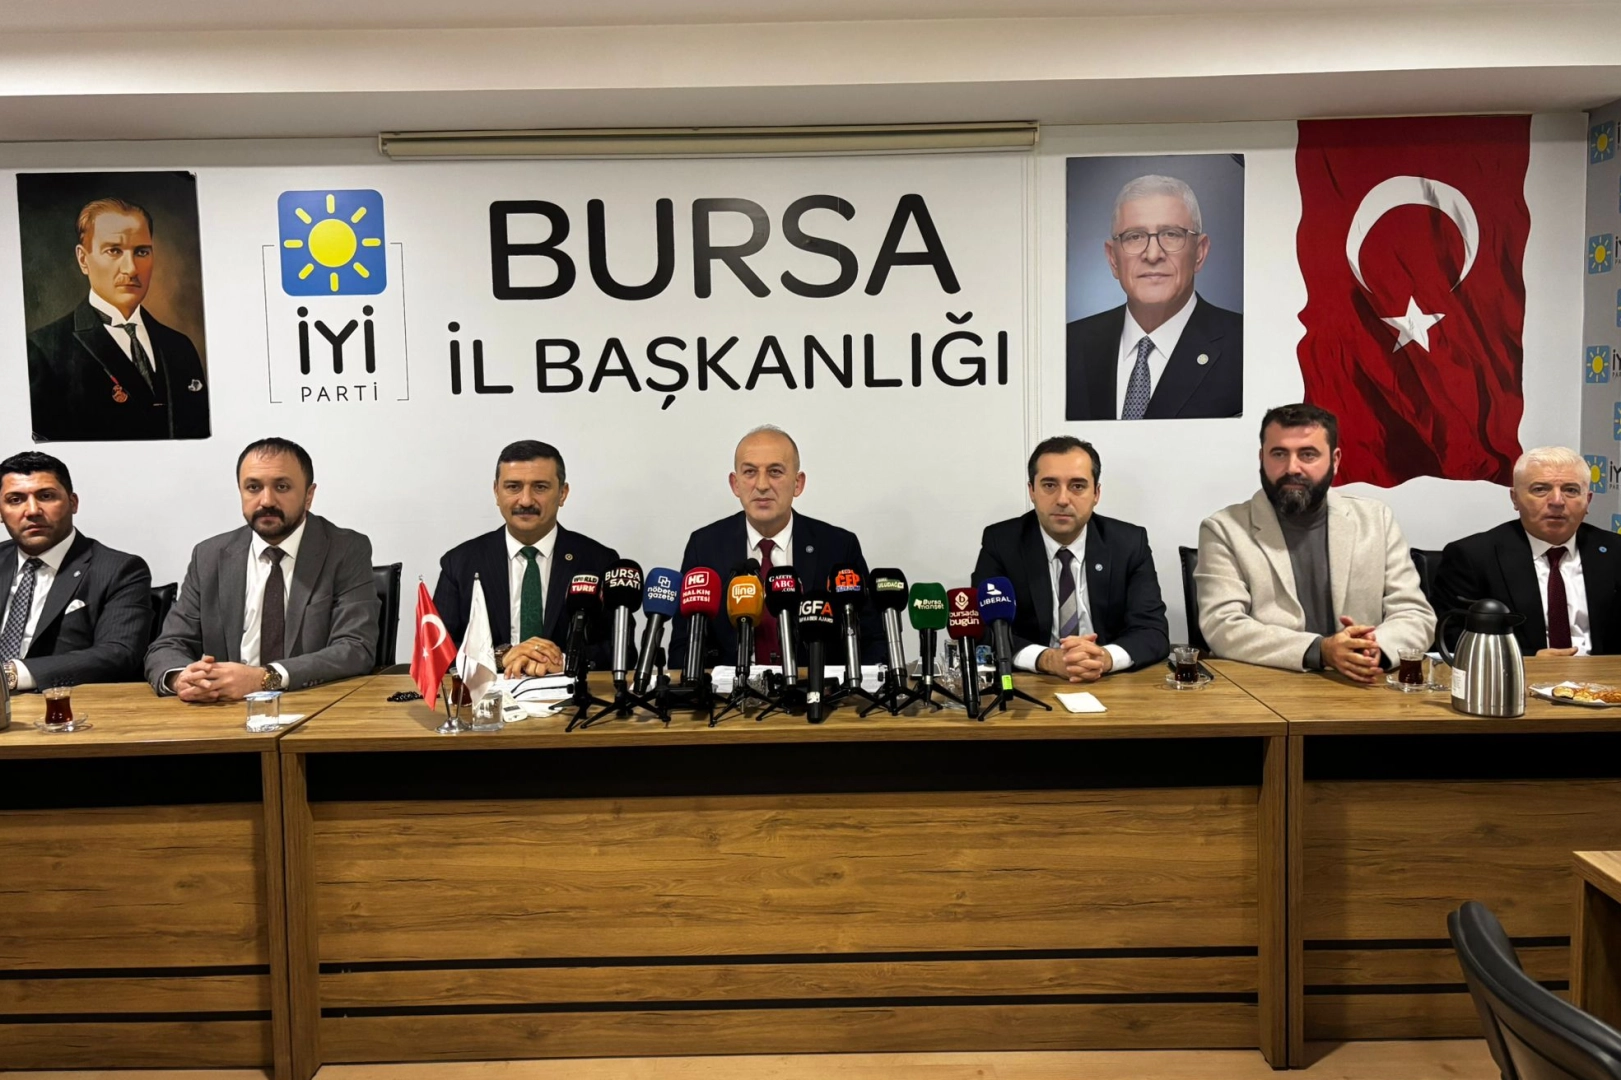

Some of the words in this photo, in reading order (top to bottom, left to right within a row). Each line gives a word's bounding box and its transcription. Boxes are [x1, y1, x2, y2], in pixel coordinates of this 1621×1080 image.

[489, 194, 962, 300] BURSA
[297, 305, 376, 375] İYİ
[448, 321, 514, 395] İL
[536, 311, 1008, 411] BAŞKANLIĞI
[301, 382, 378, 402] PARTİ
[605, 568, 641, 581] BURSA
[688, 574, 704, 585] HG
[774, 580, 794, 589] ABC
[949, 610, 979, 618] bursada
[950, 616, 980, 627] bugün
